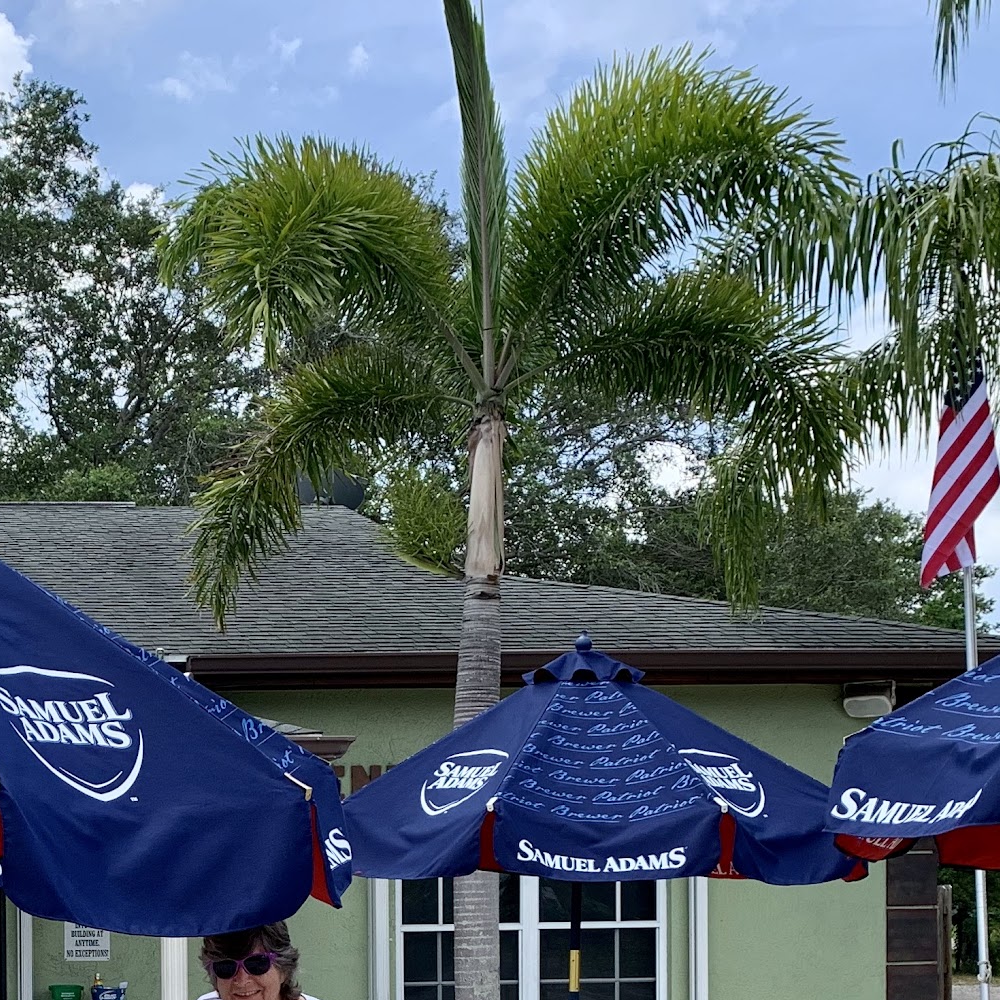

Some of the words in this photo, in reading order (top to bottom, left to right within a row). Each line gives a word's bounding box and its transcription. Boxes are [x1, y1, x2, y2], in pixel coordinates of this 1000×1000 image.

[546, 702, 613, 717] Brewer
[19, 716, 133, 749] ADAMS
[548, 735, 617, 750] Brewer
[523, 743, 584, 765] Brewer
[590, 749, 662, 767] Patriot
[433, 761, 502, 778] SAMUEL
[549, 769, 621, 785] Brewer
[426, 776, 489, 790] ADAMS
[519, 778, 588, 801] Brewer
[592, 786, 665, 802] Patriot
[551, 805, 625, 820] Brewer
[629, 794, 700, 819] Patriot
[830, 787, 937, 825] SAMUEL
[516, 839, 602, 873] SAMUEL
[603, 847, 686, 874] ADAMS
[71, 930, 96, 938] BUILDING
[97, 930, 104, 938] AT
[66, 949, 74, 958] NO
[75, 949, 109, 958] EXCEPTIONS!
